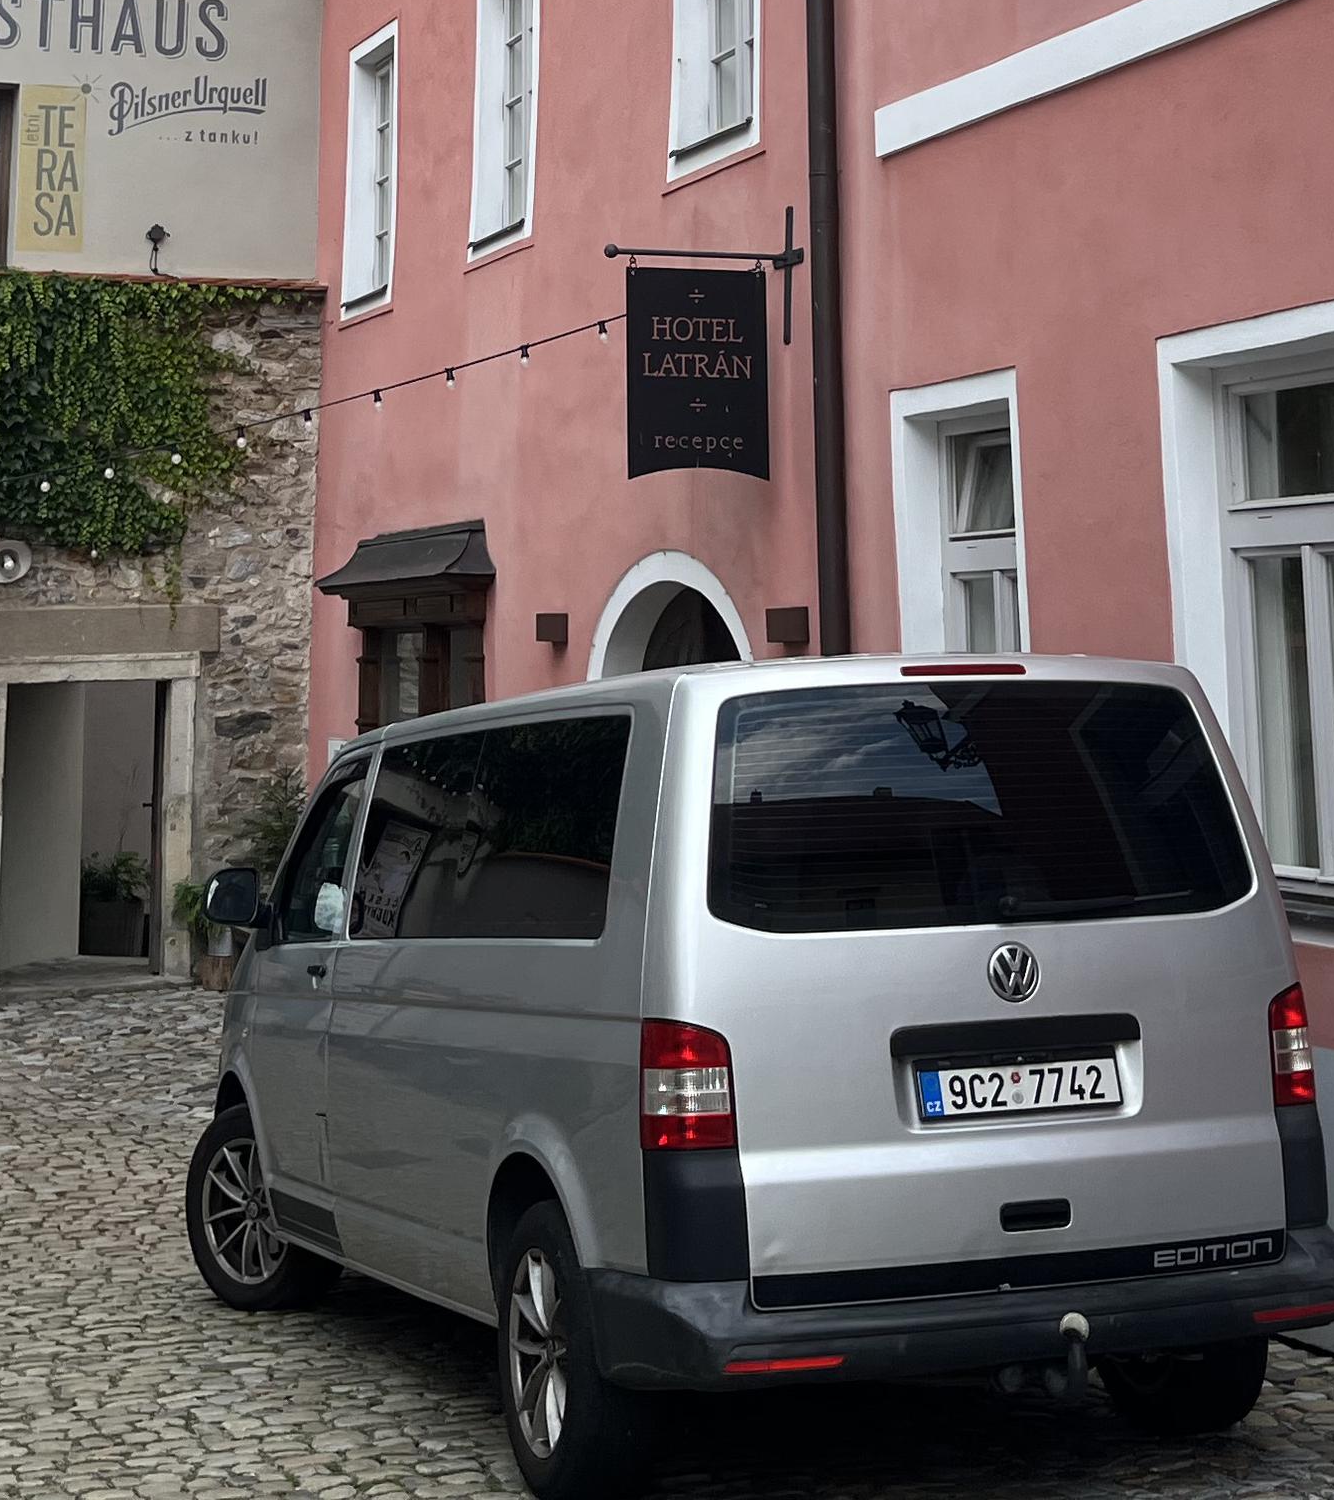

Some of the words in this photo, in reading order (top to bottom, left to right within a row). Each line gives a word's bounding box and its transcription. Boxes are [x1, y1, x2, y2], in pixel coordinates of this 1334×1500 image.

[108, 81, 192, 136] Pilsner
[194, 75, 267, 115] Urquell
[200, 129, 258, 145] tanku!
[651, 316, 744, 343] HOTEL
[643, 351, 752, 380] LATRÁN
[654, 435, 743, 452] recepce
[949, 1072, 1007, 1110] 9C2
[1029, 1065, 1105, 1104] 7742
[926, 1100, 942, 1113] CZ
[1154, 1238, 1272, 1268] EDITION
